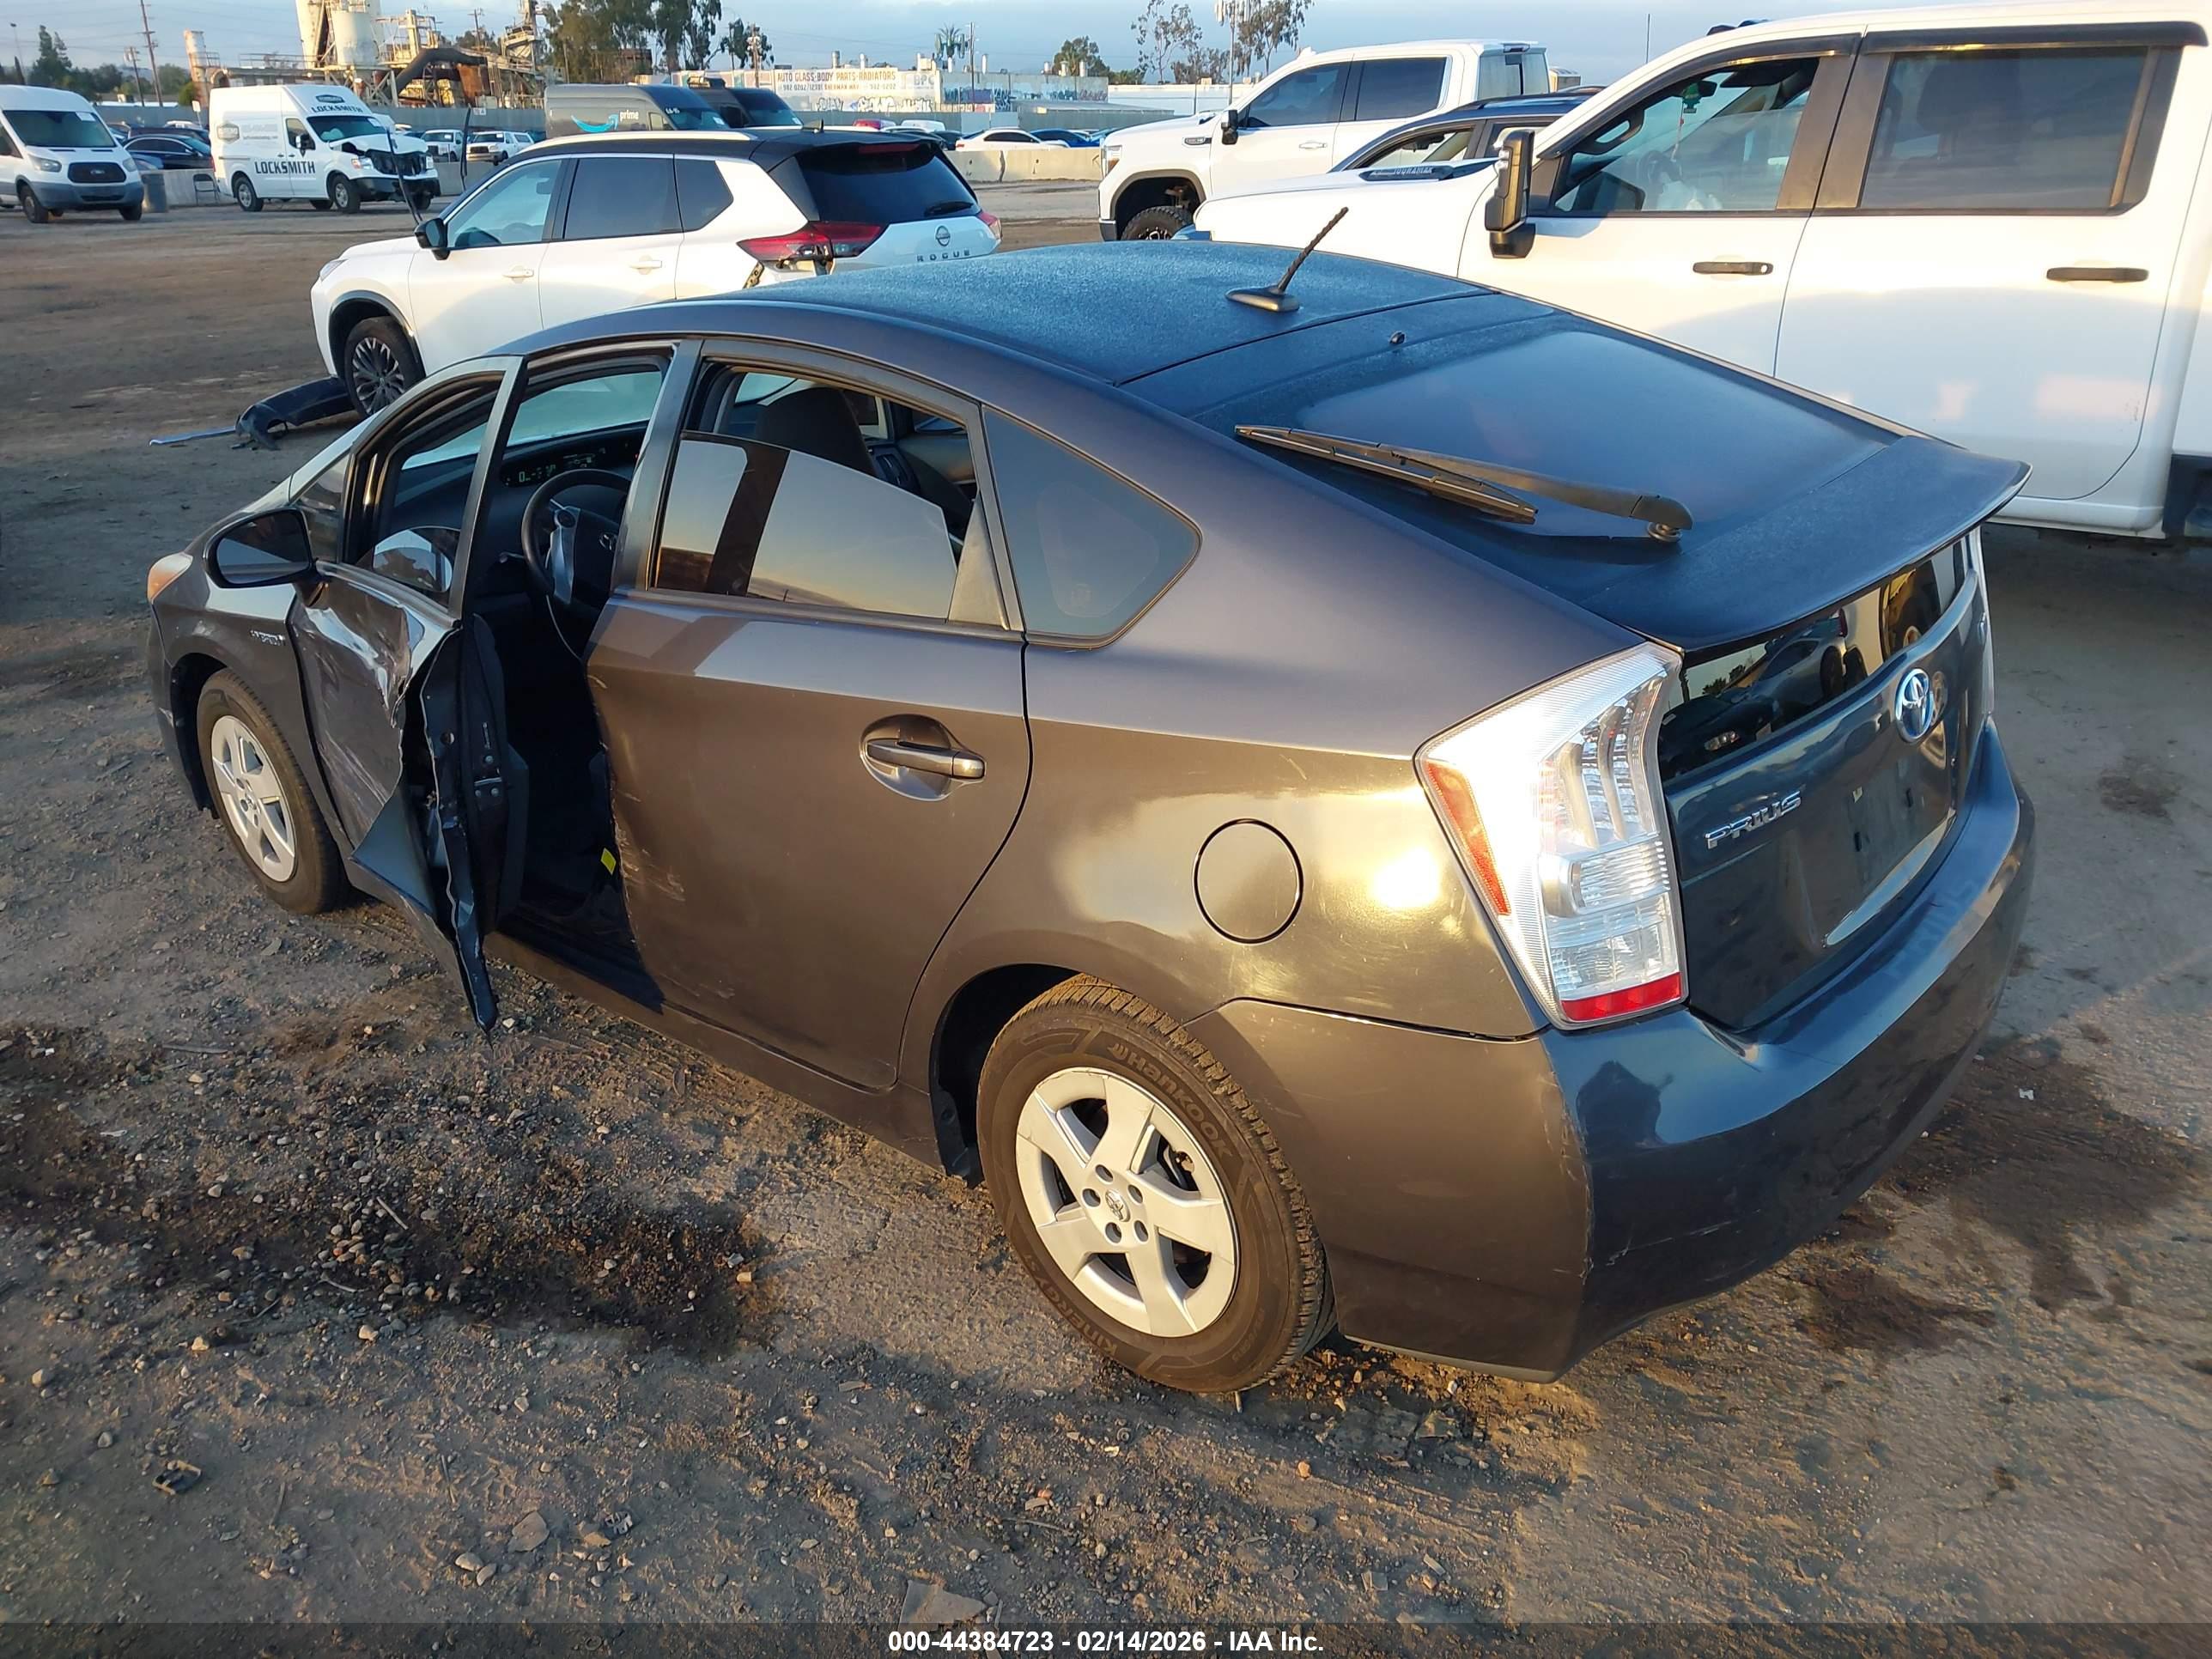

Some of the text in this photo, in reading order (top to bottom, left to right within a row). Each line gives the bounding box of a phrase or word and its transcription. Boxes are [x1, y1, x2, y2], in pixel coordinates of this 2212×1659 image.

[777, 72, 793, 82] AUTO
[620, 110, 639, 122] prime
[254, 161, 316, 174] LOCKSMITH
[917, 249, 971, 262] ROGUE
[1705, 790, 1802, 849] PRIUS
